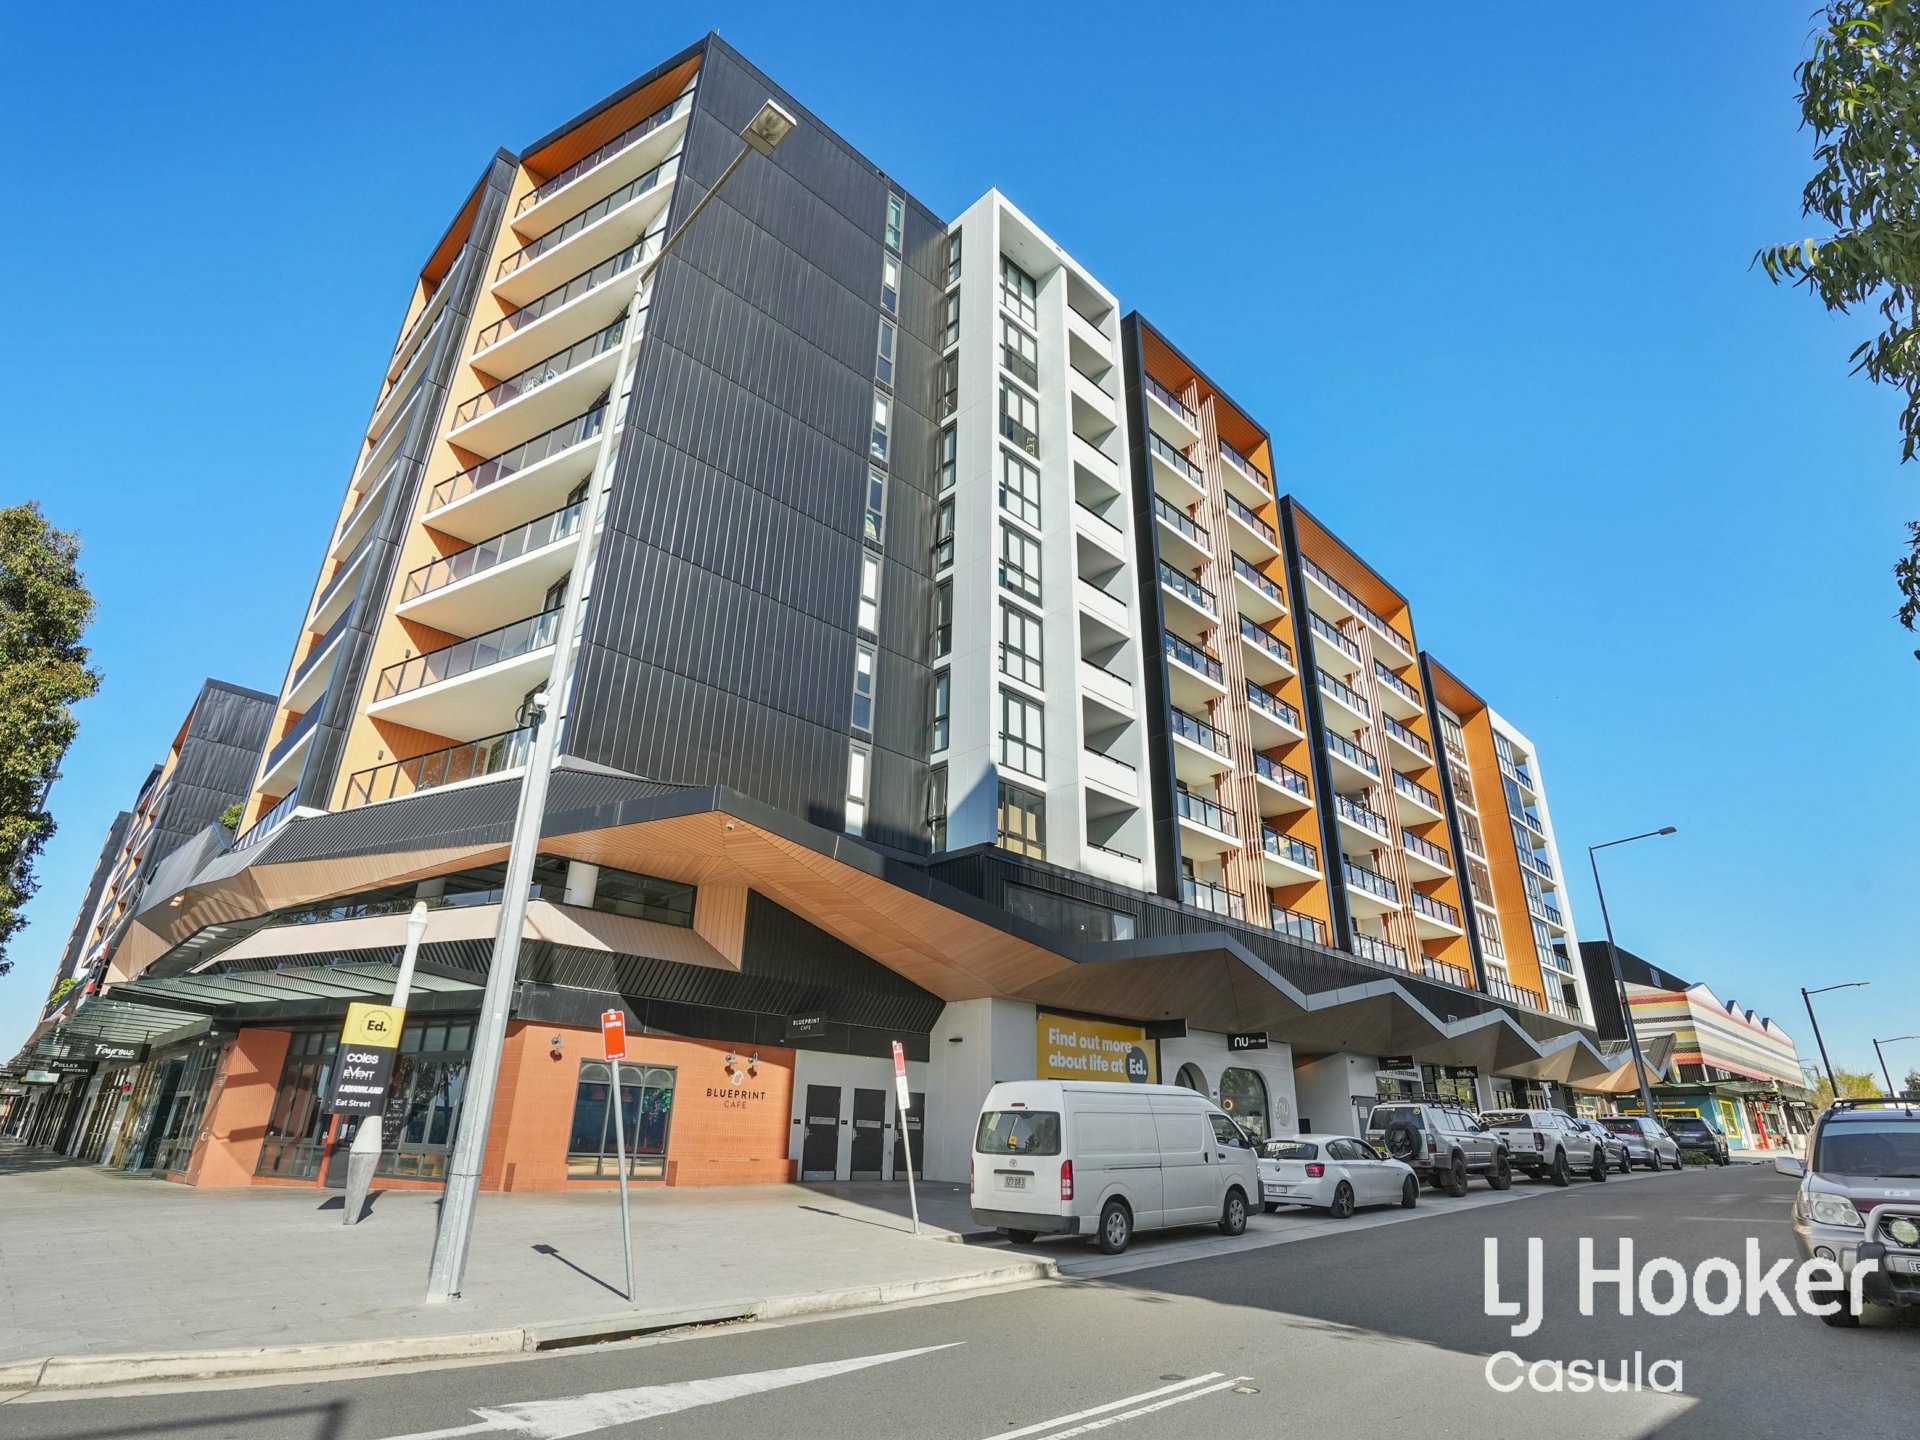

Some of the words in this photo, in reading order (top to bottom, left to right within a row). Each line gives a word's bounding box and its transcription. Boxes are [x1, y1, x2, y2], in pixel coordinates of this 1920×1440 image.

[366, 1020, 387, 1032] Ed.
[1048, 1028, 1077, 1047] Find
[1079, 1036, 1100, 1050] out
[1102, 1039, 1132, 1053] more
[346, 1053, 379, 1064] coles
[1049, 1051, 1087, 1070] about
[1089, 1054, 1108, 1072] life
[1110, 1059, 1124, 1073] at
[1129, 1058, 1147, 1075] Ed.
[338, 1084, 384, 1094] LIQUORLAND
[706, 1088, 765, 1100] BLUEPRINT
[349, 1100, 371, 1108] Street
[724, 1100, 747, 1109] CAFE
